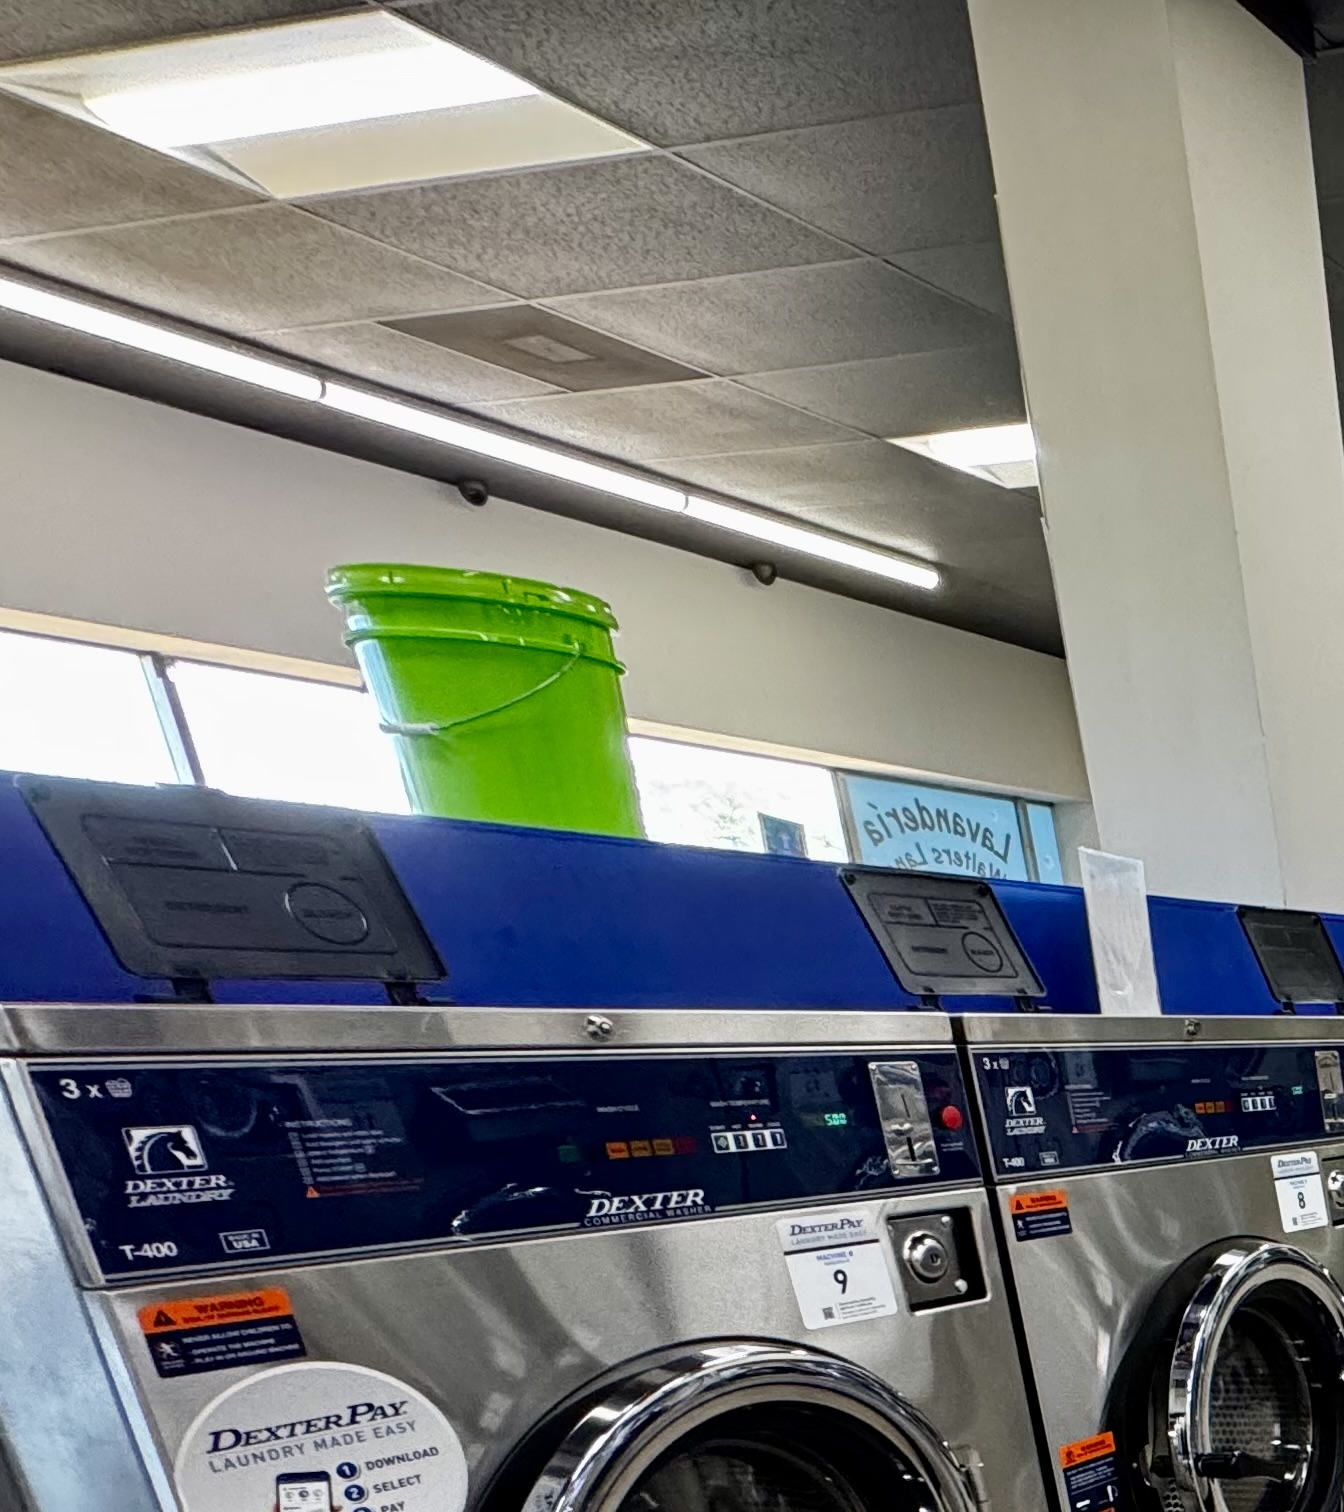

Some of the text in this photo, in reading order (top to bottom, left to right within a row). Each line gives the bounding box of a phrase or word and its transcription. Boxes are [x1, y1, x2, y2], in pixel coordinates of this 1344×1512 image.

[982, 1057, 991, 1070] 3
[59, 1078, 81, 1099] 3
[1186, 1135, 1239, 1152] DEXTER
[124, 1175, 228, 1194] DEXTER
[127, 1189, 236, 1208] LAUNDRY
[586, 1189, 705, 1217] DEXTER
[1297, 1191, 1306, 1209] 8
[584, 1205, 712, 1227] COMMERCIAL WASHER
[118, 1241, 178, 1260] T-400
[833, 1269, 848, 1294] 9
[193, 1297, 264, 1314] WARNING
[208, 1420, 417, 1473] LAUNDRY MADE EASY
[364, 1446, 439, 1471] DOWNLOAD
[373, 1474, 422, 1494] SELECT
